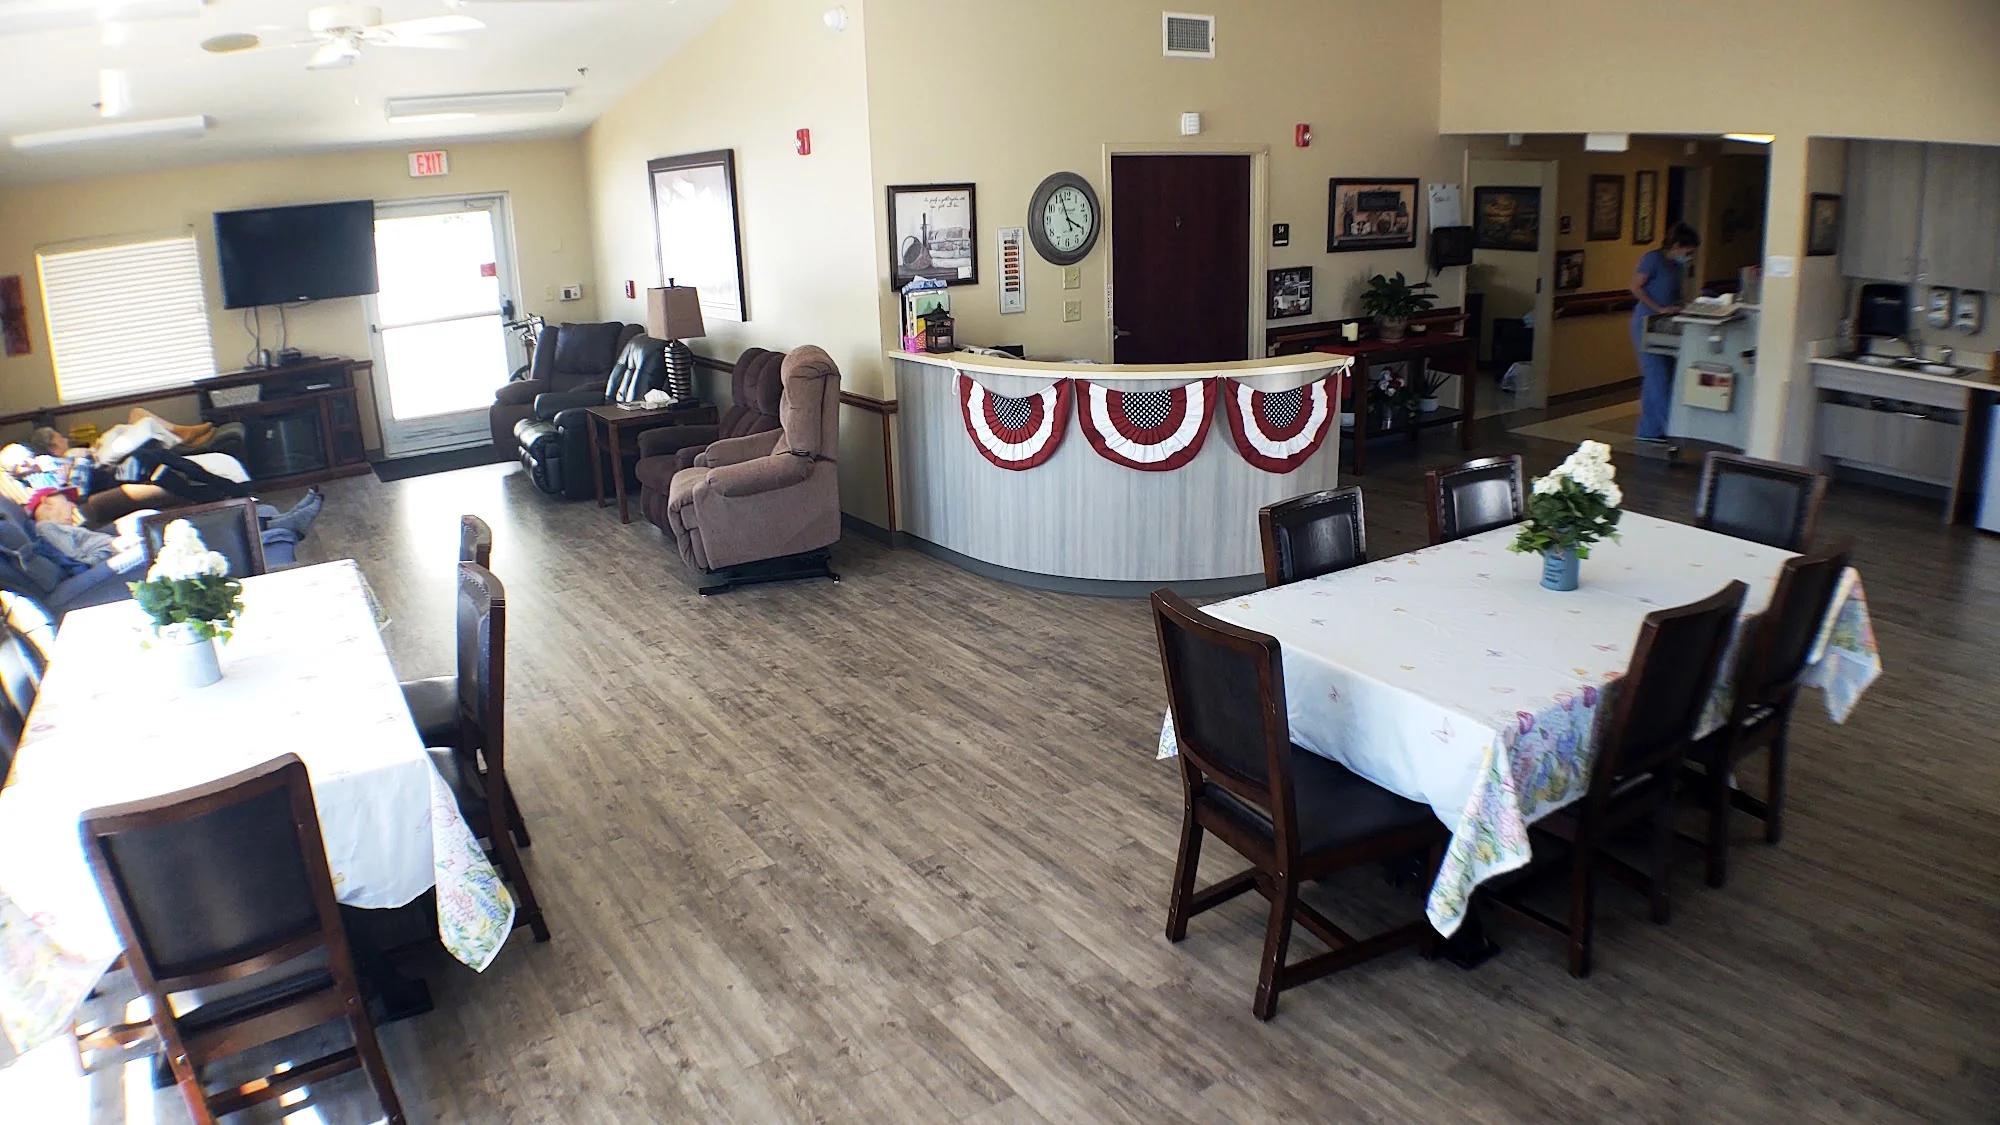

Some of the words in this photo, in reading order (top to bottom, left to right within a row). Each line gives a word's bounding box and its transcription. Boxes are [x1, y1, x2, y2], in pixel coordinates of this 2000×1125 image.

[416, 152, 442, 175] EXIT
[1064, 192, 1071, 201] 12
[1048, 204, 1055, 213] 10
[1080, 203, 1085, 212] 2
[1049, 228, 1055, 237] 8
[1064, 238, 1070, 247] 6
[1074, 234, 1079, 244] 5
